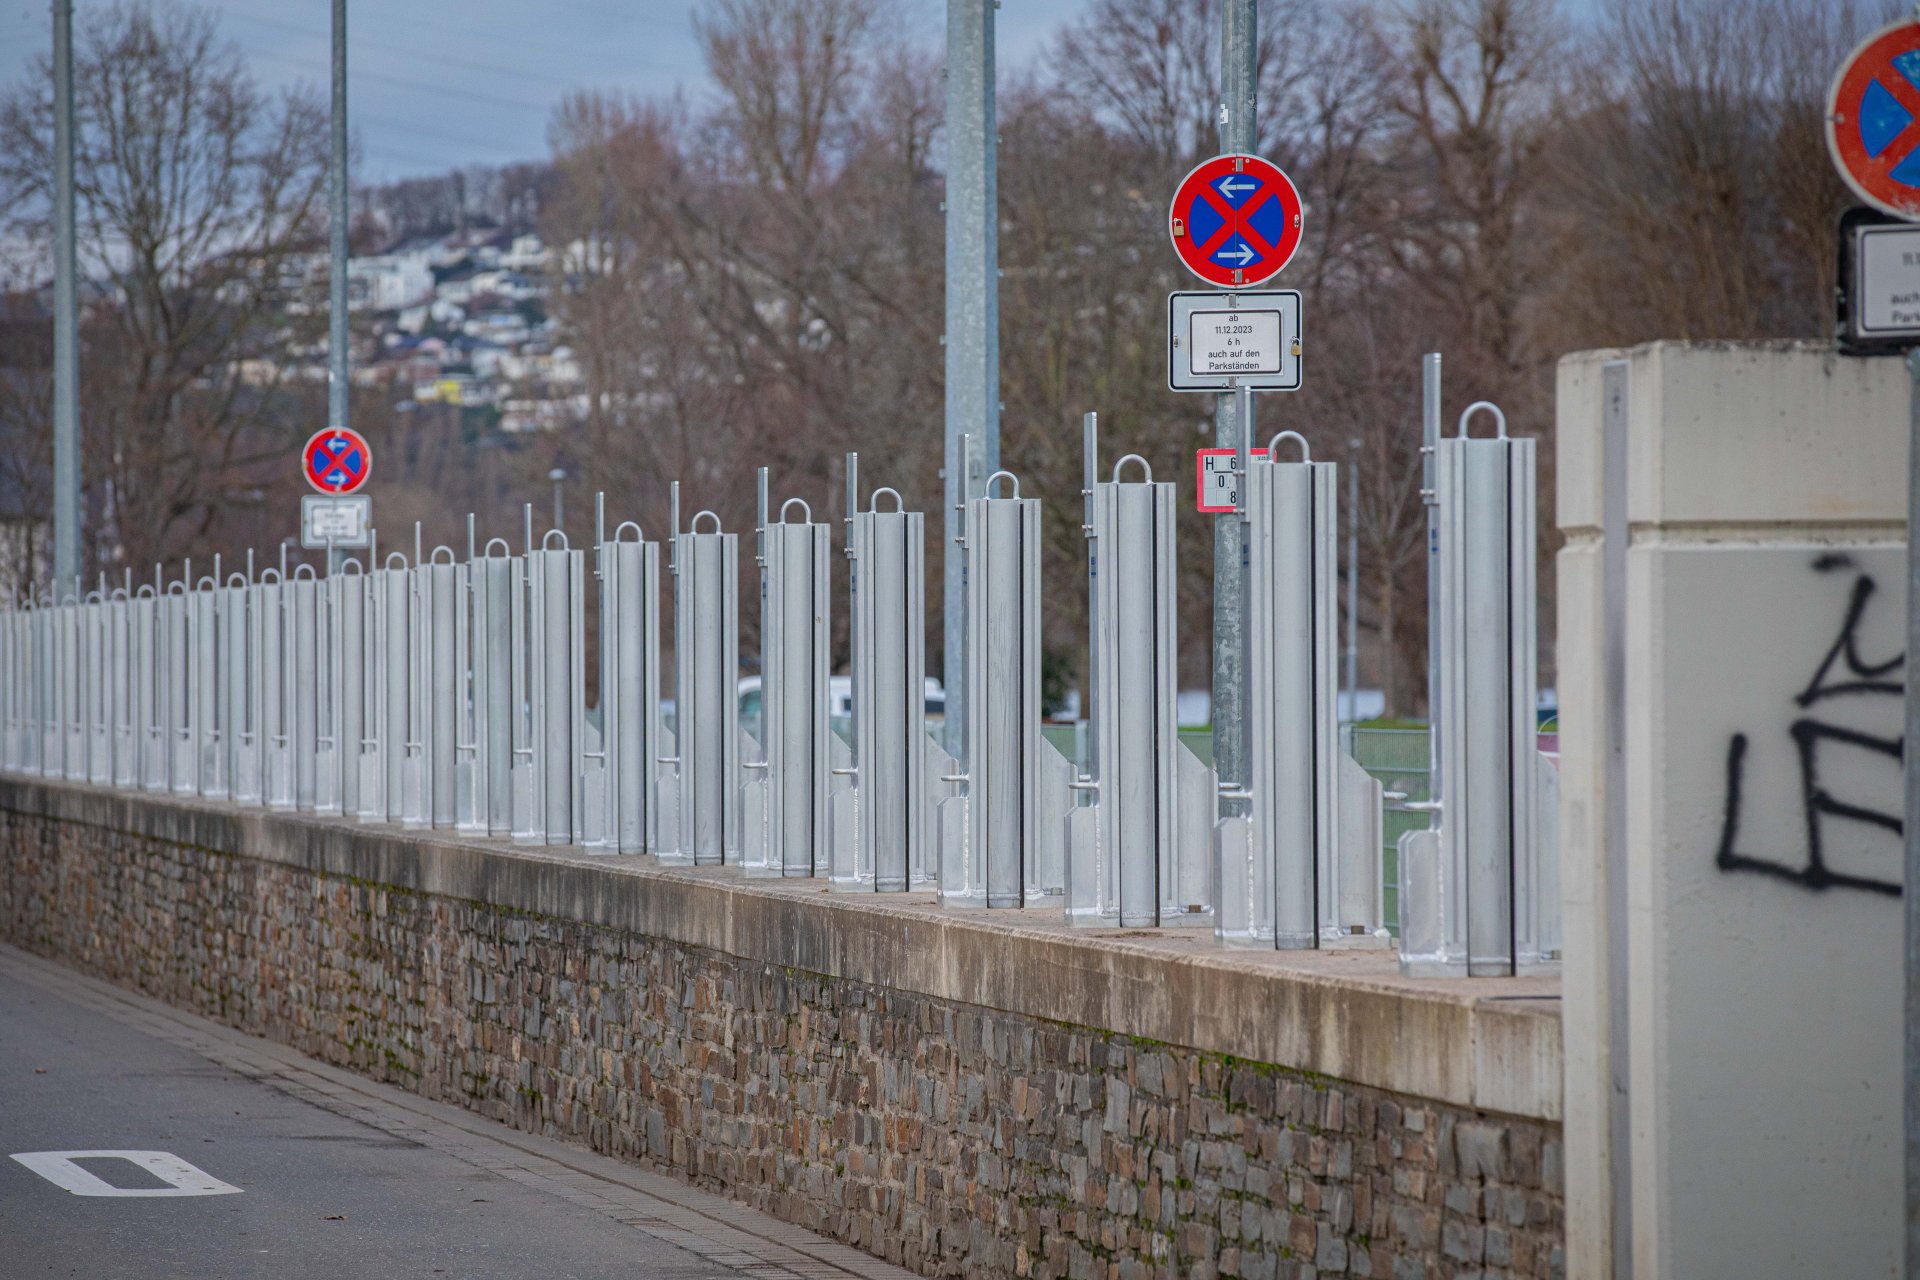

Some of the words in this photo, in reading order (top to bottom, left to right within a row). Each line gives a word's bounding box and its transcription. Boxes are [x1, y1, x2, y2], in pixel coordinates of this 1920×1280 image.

[1228, 314, 1239, 322] ab
[1215, 325, 1253, 334] 11.12.2023
[1227, 338, 1232, 346] 6
[1235, 338, 1241, 346] h
[1208, 350, 1228, 358] auch
[1229, 350, 1243, 358] auf
[1245, 349, 1260, 358] den
[1208, 361, 1260, 370] Parkständen
[1205, 456, 1214, 471] H
